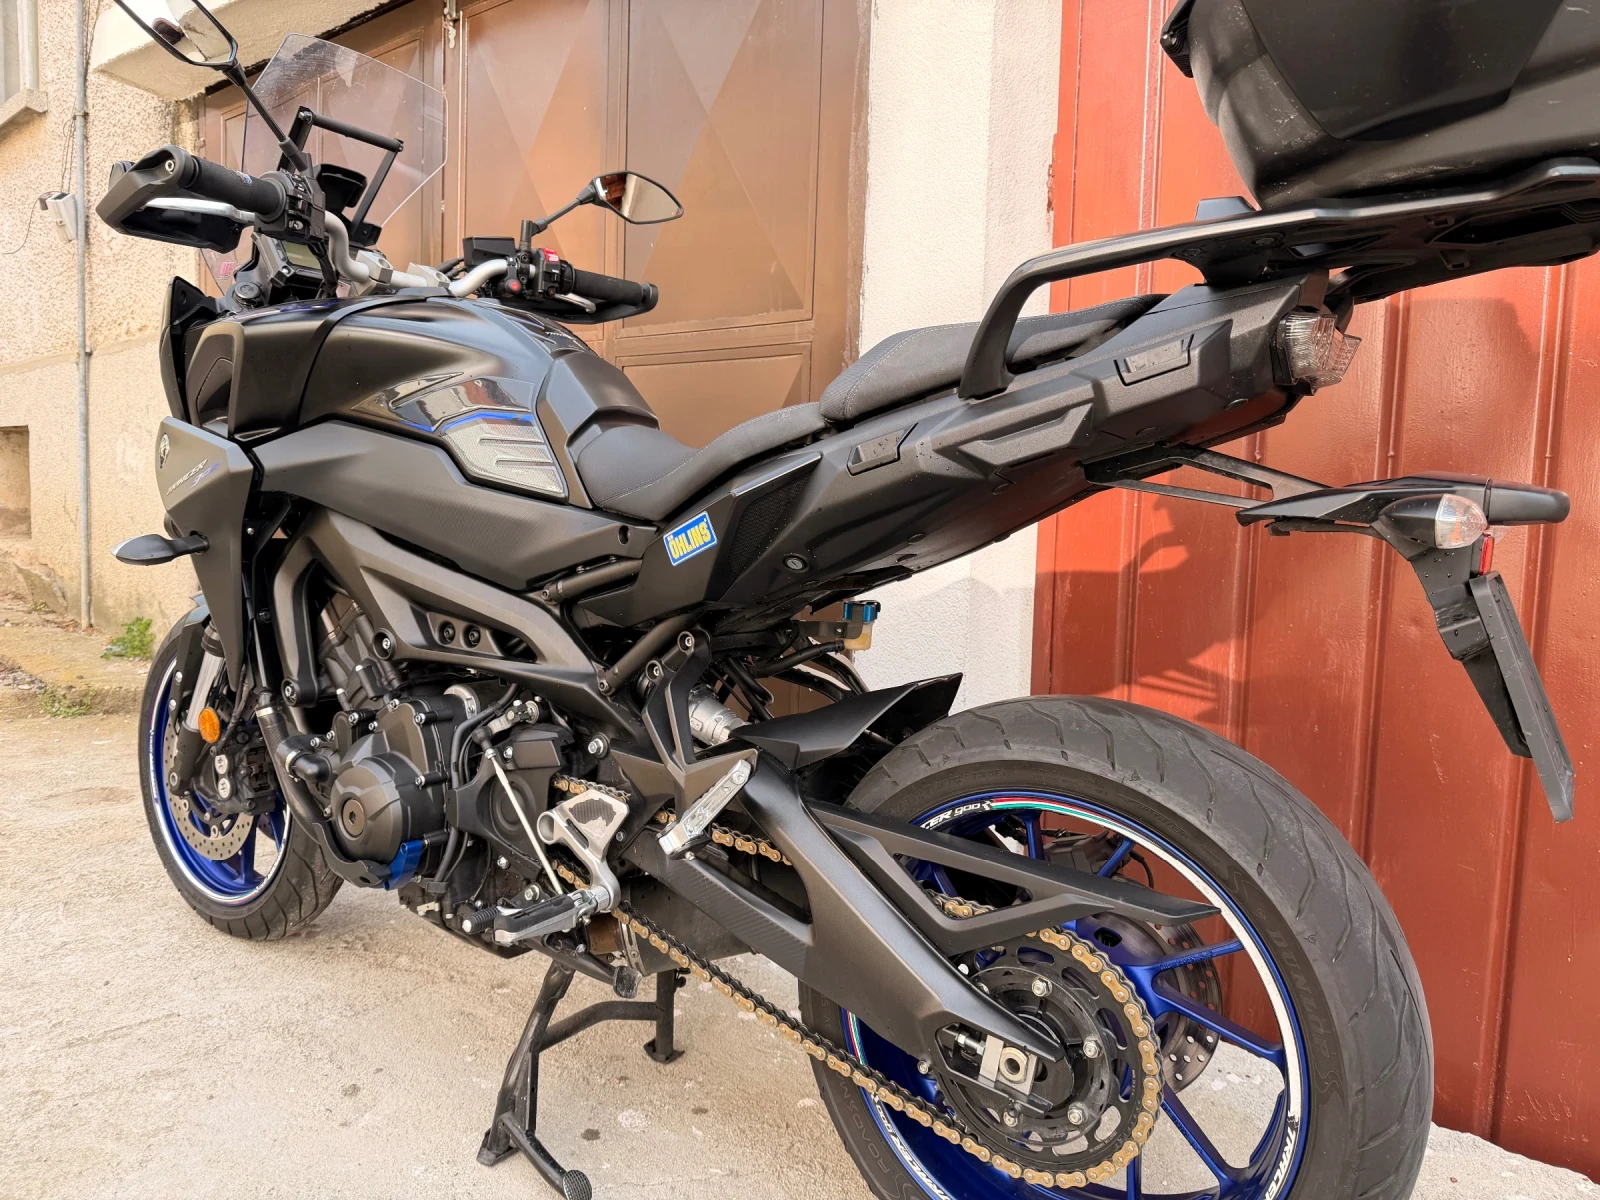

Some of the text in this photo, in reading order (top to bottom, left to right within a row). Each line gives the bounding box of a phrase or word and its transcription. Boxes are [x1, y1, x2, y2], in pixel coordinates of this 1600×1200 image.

[667, 522, 711, 559] ÖHLINS
[920, 802, 981, 830] CER 900
[1265, 928, 1331, 1058] DUNLOP
